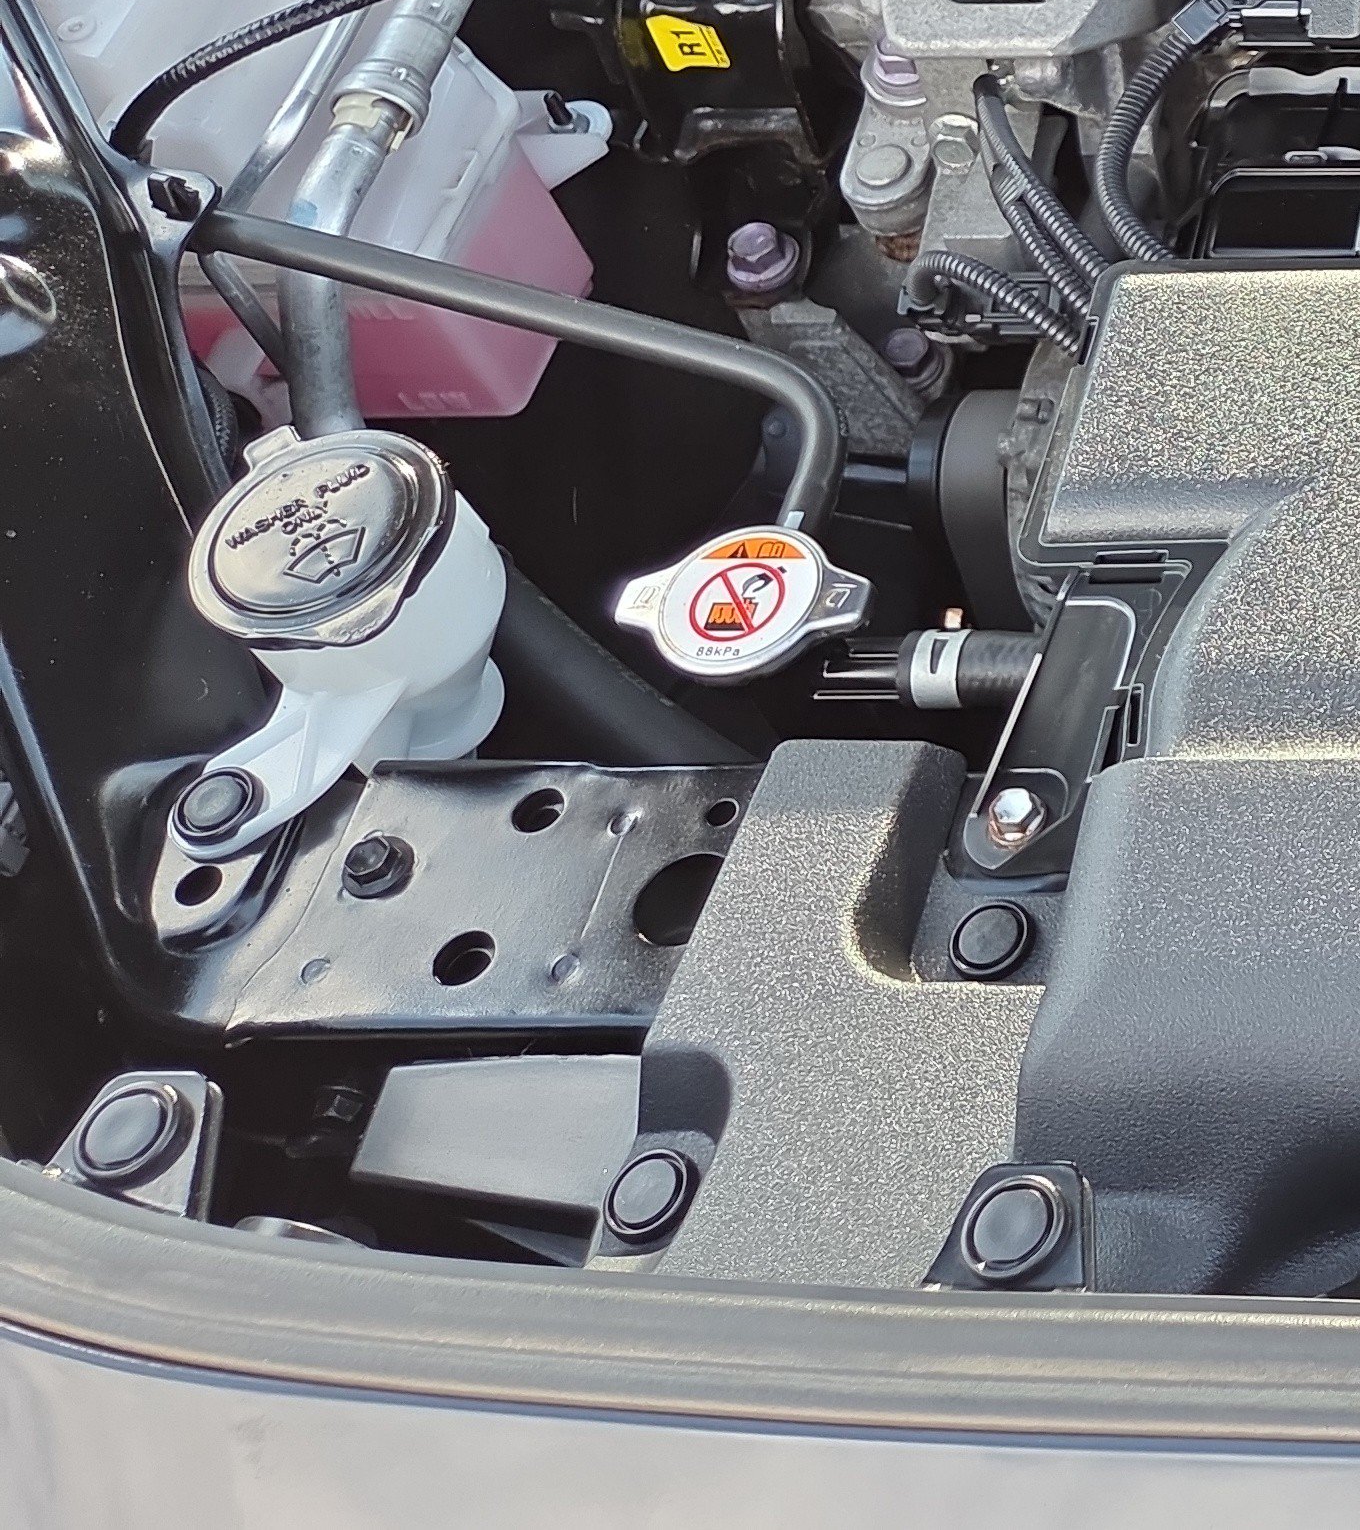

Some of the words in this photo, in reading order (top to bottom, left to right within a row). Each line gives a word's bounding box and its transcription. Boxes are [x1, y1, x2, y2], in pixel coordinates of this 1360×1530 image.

[669, 30, 708, 57] R1
[398, 390, 473, 413] LOW
[224, 498, 309, 550] WASHER
[314, 463, 372, 499] FLUID
[280, 508, 323, 536] ONLY
[696, 646, 740, 657] 88kPa
